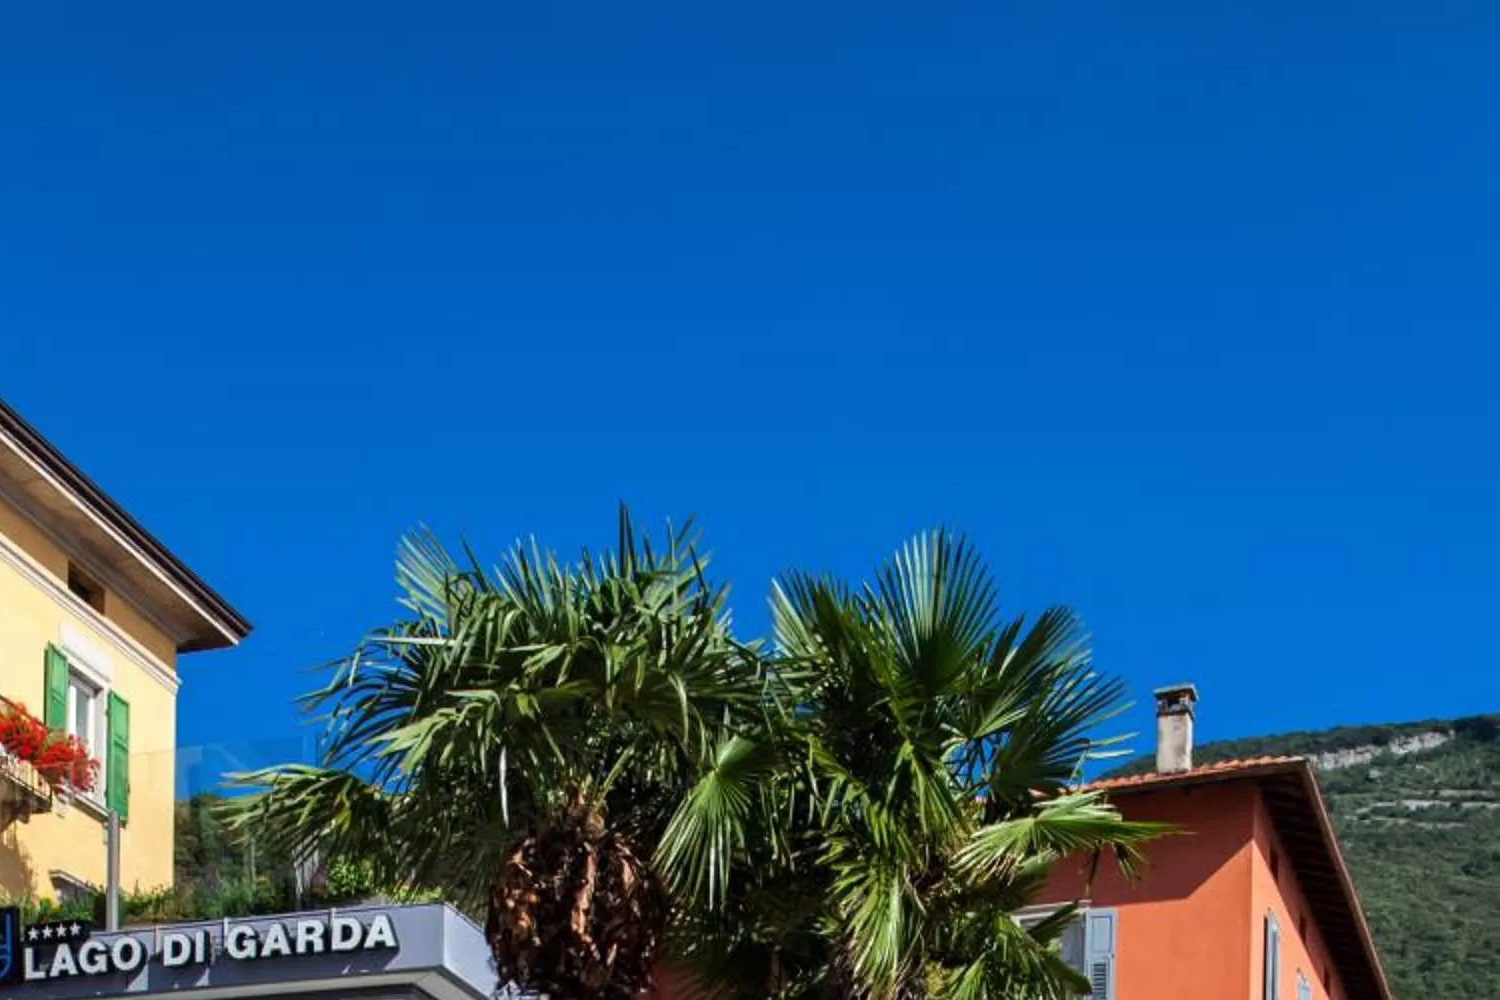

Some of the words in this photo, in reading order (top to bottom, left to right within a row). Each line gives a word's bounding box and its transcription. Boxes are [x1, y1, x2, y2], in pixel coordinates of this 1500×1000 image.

[23, 934, 146, 982] LAGO
[162, 928, 208, 969] DI
[224, 914, 397, 960] GARDA
